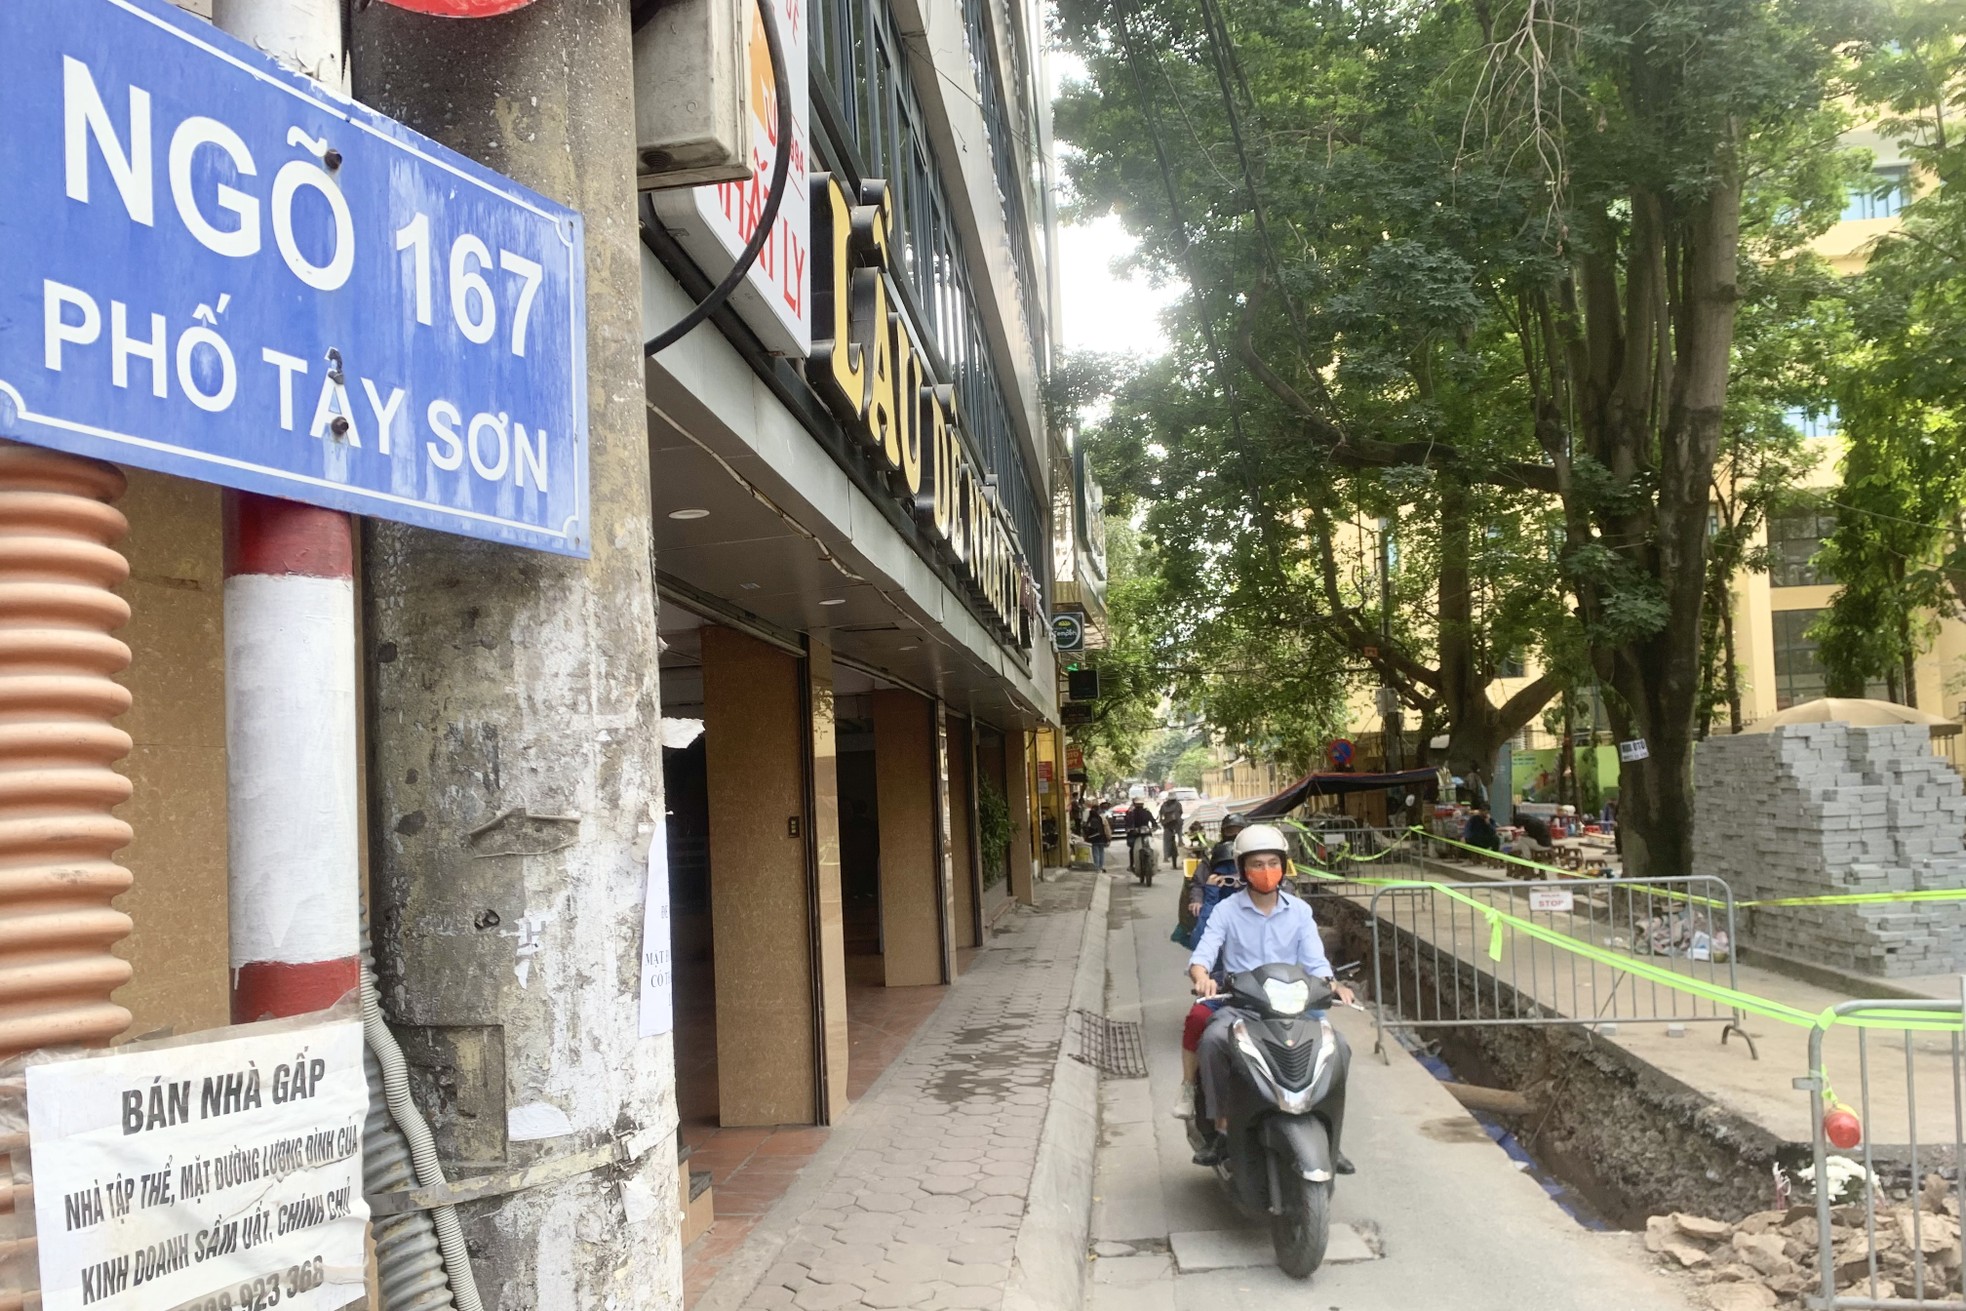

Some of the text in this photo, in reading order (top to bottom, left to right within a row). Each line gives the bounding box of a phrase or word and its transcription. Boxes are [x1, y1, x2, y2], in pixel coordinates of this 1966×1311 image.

[62, 54, 543, 358] NGÕ 167
[783, 216, 805, 321] LY
[43, 278, 548, 493] PHỐ TÂY SƠN
[121, 1046, 325, 1136] BÁN NHÀ GẤP
[64, 1179, 104, 1231] NHÀ
[106, 1173, 134, 1224] TẬP
[140, 1154, 175, 1209] THỂ,
[180, 1154, 210, 1204] MẶT
[214, 1145, 260, 1190] ĐƯỜNG
[263, 1138, 303, 1178] LƯƠNG
[337, 1115, 358, 1158] CỦA
[81, 1255, 129, 1306] KINH
[133, 1233, 189, 1286] DOANH
[194, 1214, 238, 1263] SẦM
[242, 1200, 273, 1249] UẤT,
[277, 1187, 325, 1236] CHÍNH
[327, 1176, 351, 1223] CHỦ
[239, 1273, 280, 1311] 923
[286, 1255, 325, 1299] 368
